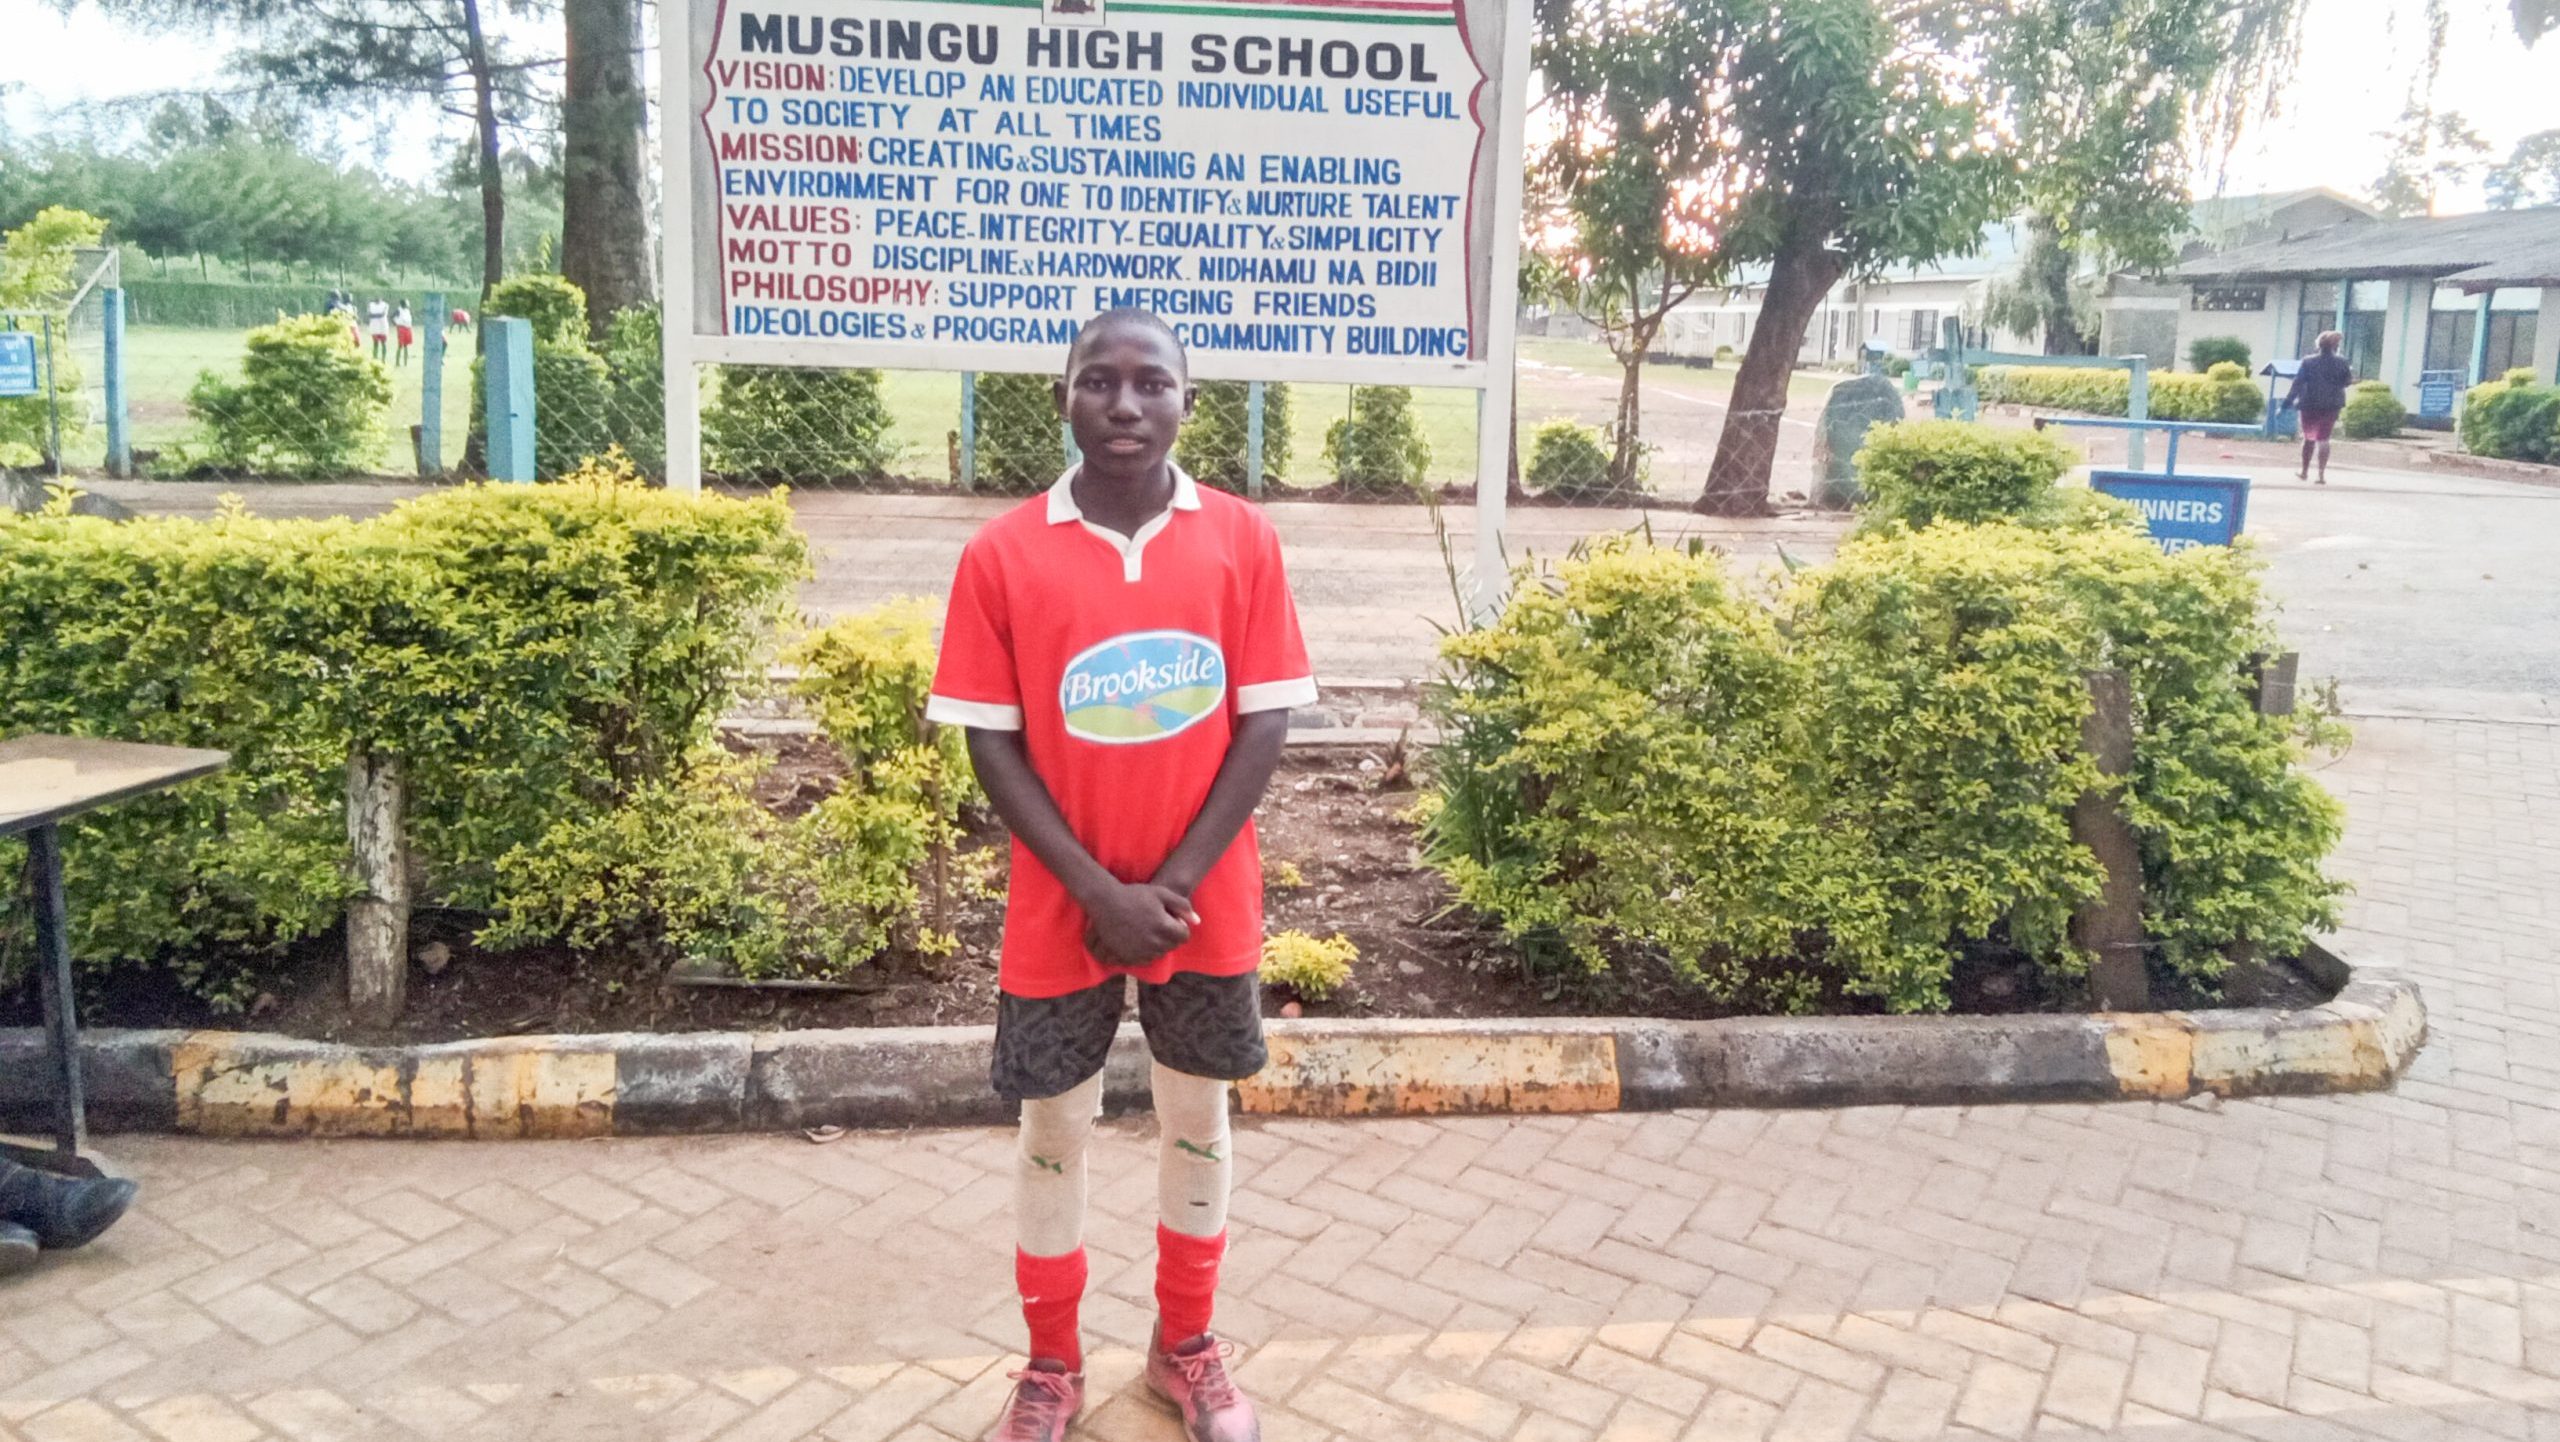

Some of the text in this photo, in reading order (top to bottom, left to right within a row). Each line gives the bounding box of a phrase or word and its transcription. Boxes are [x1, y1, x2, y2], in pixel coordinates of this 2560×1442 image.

[741, 13, 1437, 82] MUSINGU HIGH SCHOOL
[840, 65, 966, 99] DEVELOP
[979, 74, 1015, 102] AN
[1026, 75, 1163, 107] EDUCATED
[1178, 81, 1329, 113] INDIVIDUAL
[1345, 88, 1460, 120] USEFUL
[725, 96, 1162, 142] TO SOCIETY AT ALL TIMES
[725, 169, 938, 202] ENVIRONMENT
[957, 178, 1009, 205] FOR
[1021, 181, 1070, 209] ONE
[1082, 184, 1113, 210] TO
[1363, 194, 1460, 220] TALENT
[1206, 153, 1245, 181] AN
[1260, 155, 1401, 185] ENABLING
[729, 238, 852, 267] MOTTO
[1199, 255, 1316, 285] NIDHAMU
[1328, 260, 1366, 286] NA
[1376, 260, 1438, 288] BIDII
[949, 281, 1077, 311] SUPPORT
[1094, 286, 1233, 316] EMERGING
[1254, 291, 1376, 318] FRIENDS
[734, 305, 907, 339] IDEOLOGIES
[1174, 322, 1336, 354] COMMUNITY
[1347, 325, 1468, 357] BUILDING
[1066, 649, 1216, 706] Brookside
